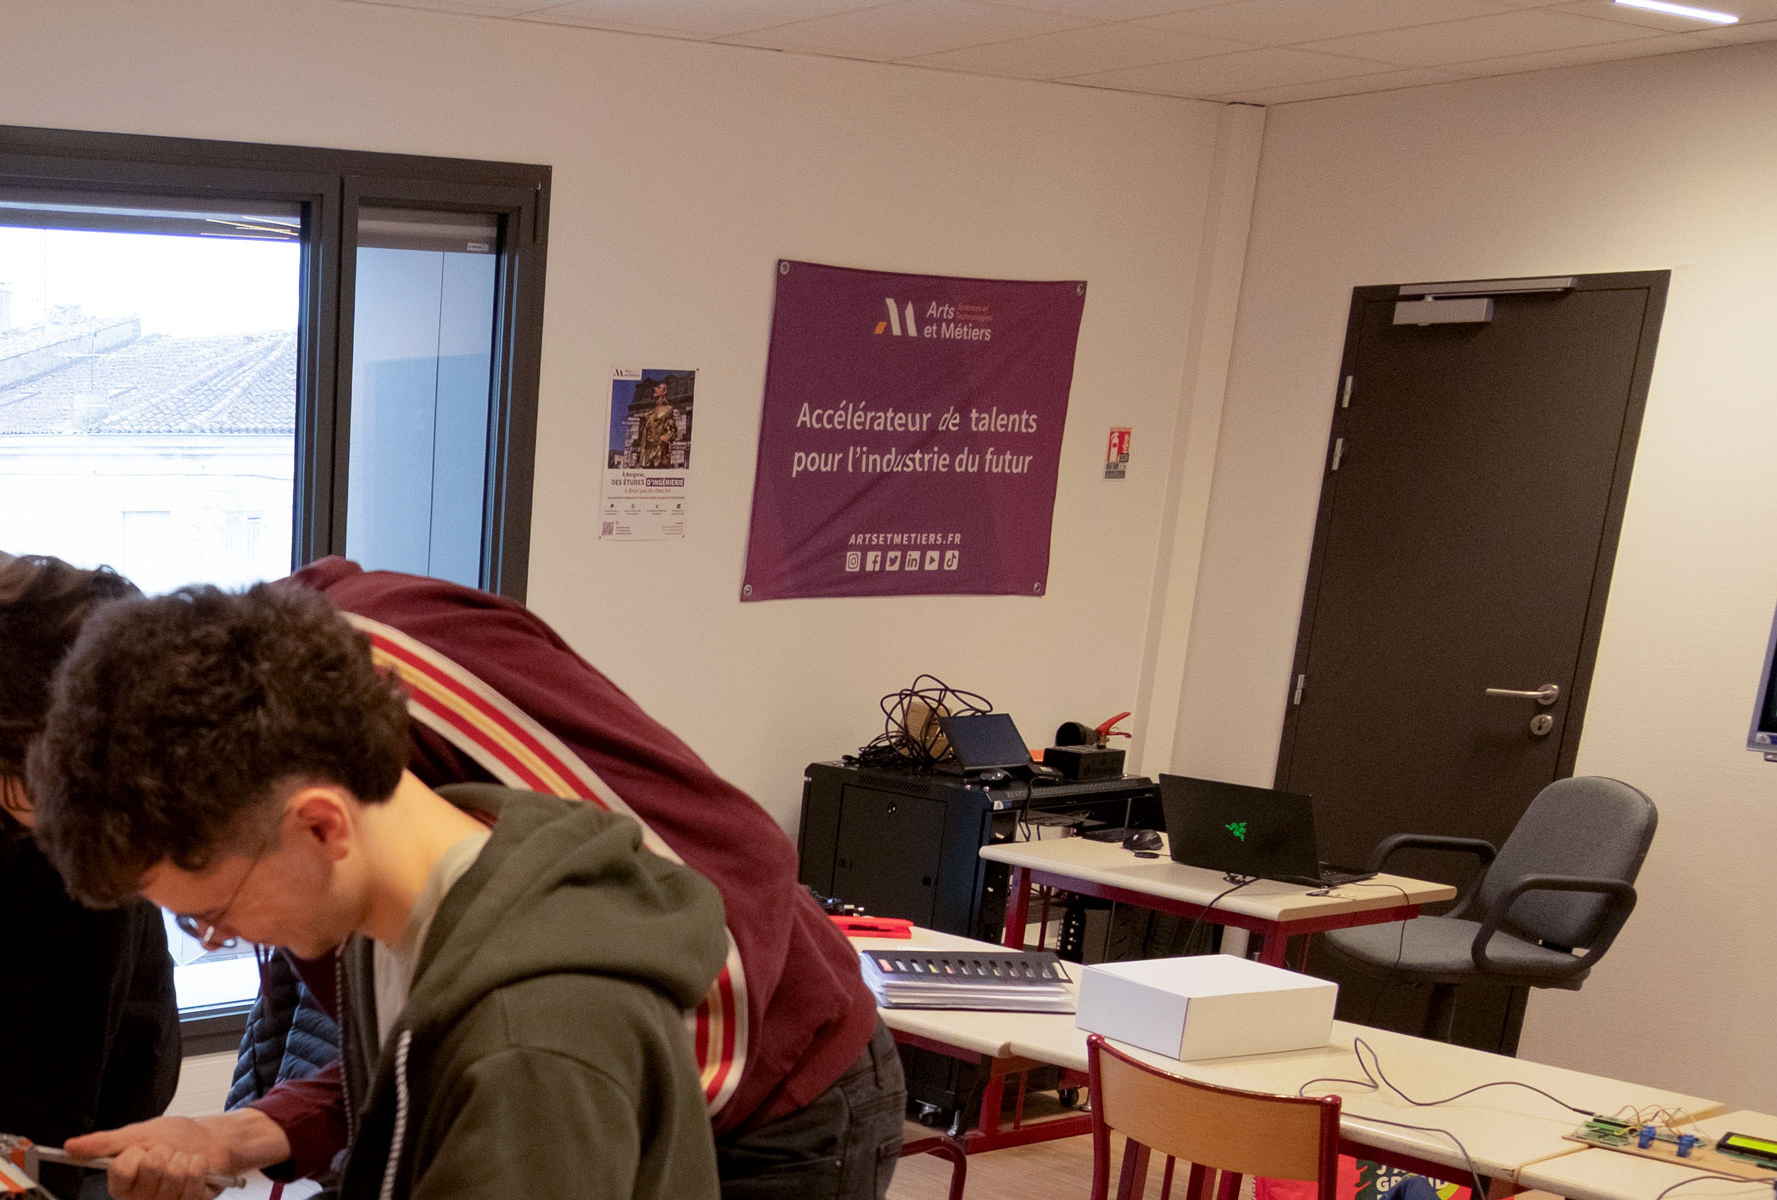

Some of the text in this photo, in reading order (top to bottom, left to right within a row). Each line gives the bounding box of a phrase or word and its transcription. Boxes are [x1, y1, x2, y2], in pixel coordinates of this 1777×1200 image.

[926, 301, 955, 319] Arts
[924, 322, 992, 341] et Métiers
[796, 400, 1038, 433] Accélérateur de talents
[792, 446, 1033, 478] pour l’industrie du futur
[848, 533, 961, 545] ARTSETMETIERS.FR
